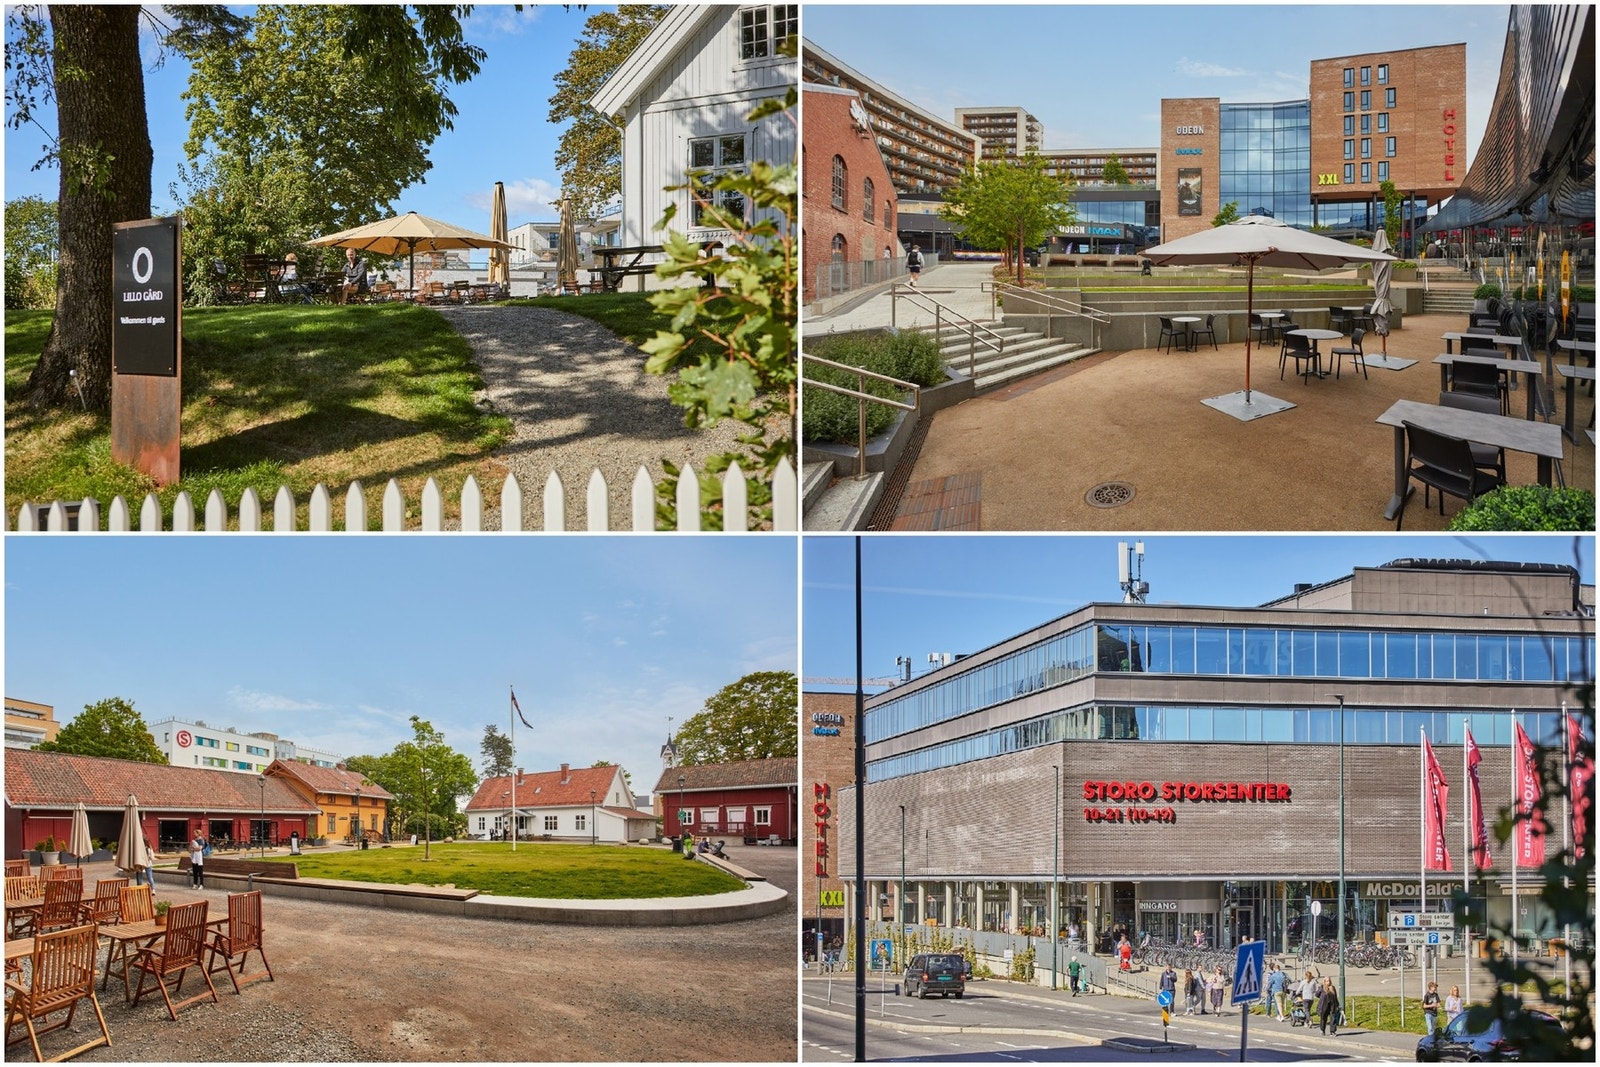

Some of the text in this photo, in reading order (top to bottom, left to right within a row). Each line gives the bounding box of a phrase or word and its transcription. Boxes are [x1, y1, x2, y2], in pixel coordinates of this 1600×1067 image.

[1176, 126, 1204, 135] ODEON
[1444, 108, 1457, 181] HOTEL
[1318, 173, 1339, 185] XXL
[1087, 226, 1121, 236] IMAX
[123, 288, 163, 302] LILLO GÅRD
[120, 316, 147, 325] Velkommen
[812, 712, 841, 722] ODEON
[1083, 781, 1290, 800] STORO STORSENTER
[1084, 807, 1175, 821] 10-21 (10-19)
[813, 783, 828, 877] HOTEL
[820, 890, 845, 906] XXL
[1139, 902, 1177, 910] INNGANG
